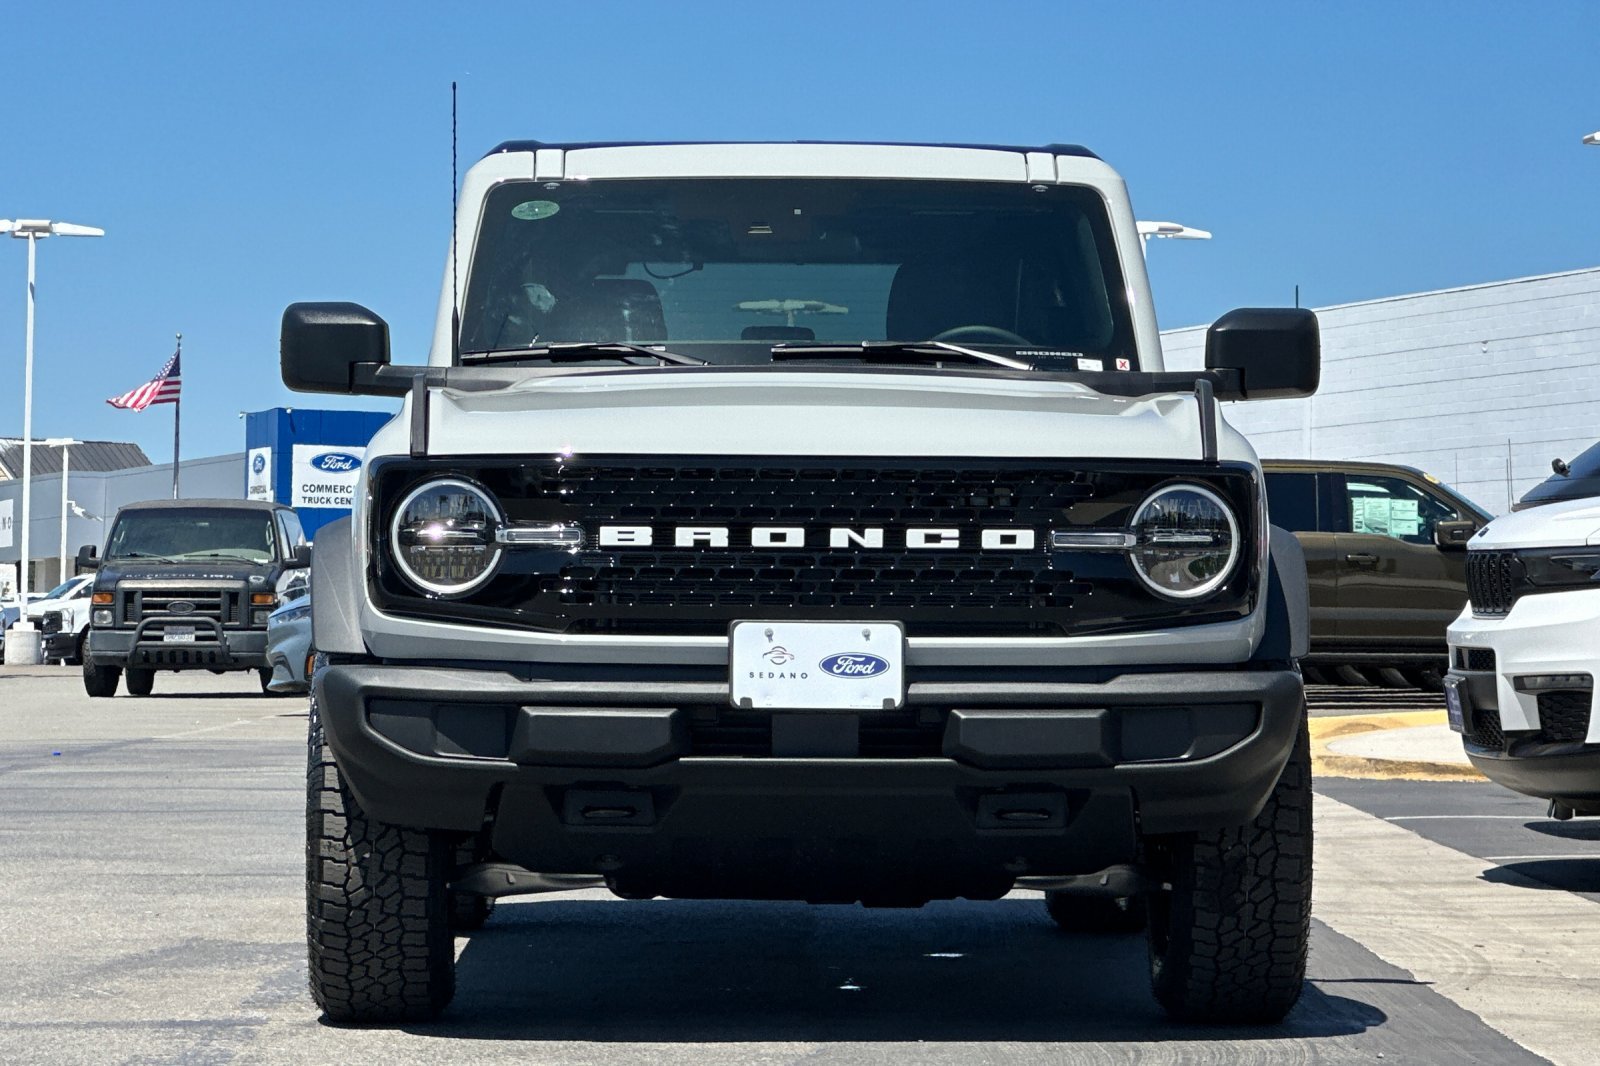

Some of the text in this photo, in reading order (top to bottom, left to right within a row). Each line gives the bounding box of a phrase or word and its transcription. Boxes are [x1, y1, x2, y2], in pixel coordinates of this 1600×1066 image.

[321, 455, 353, 470] Ford
[302, 483, 354, 494] COMMERC
[302, 496, 353, 505] TRUCK CEN
[599, 526, 1035, 549] BRONCO
[832, 655, 875, 674] Ford
[749, 671, 808, 680] SEDANO
